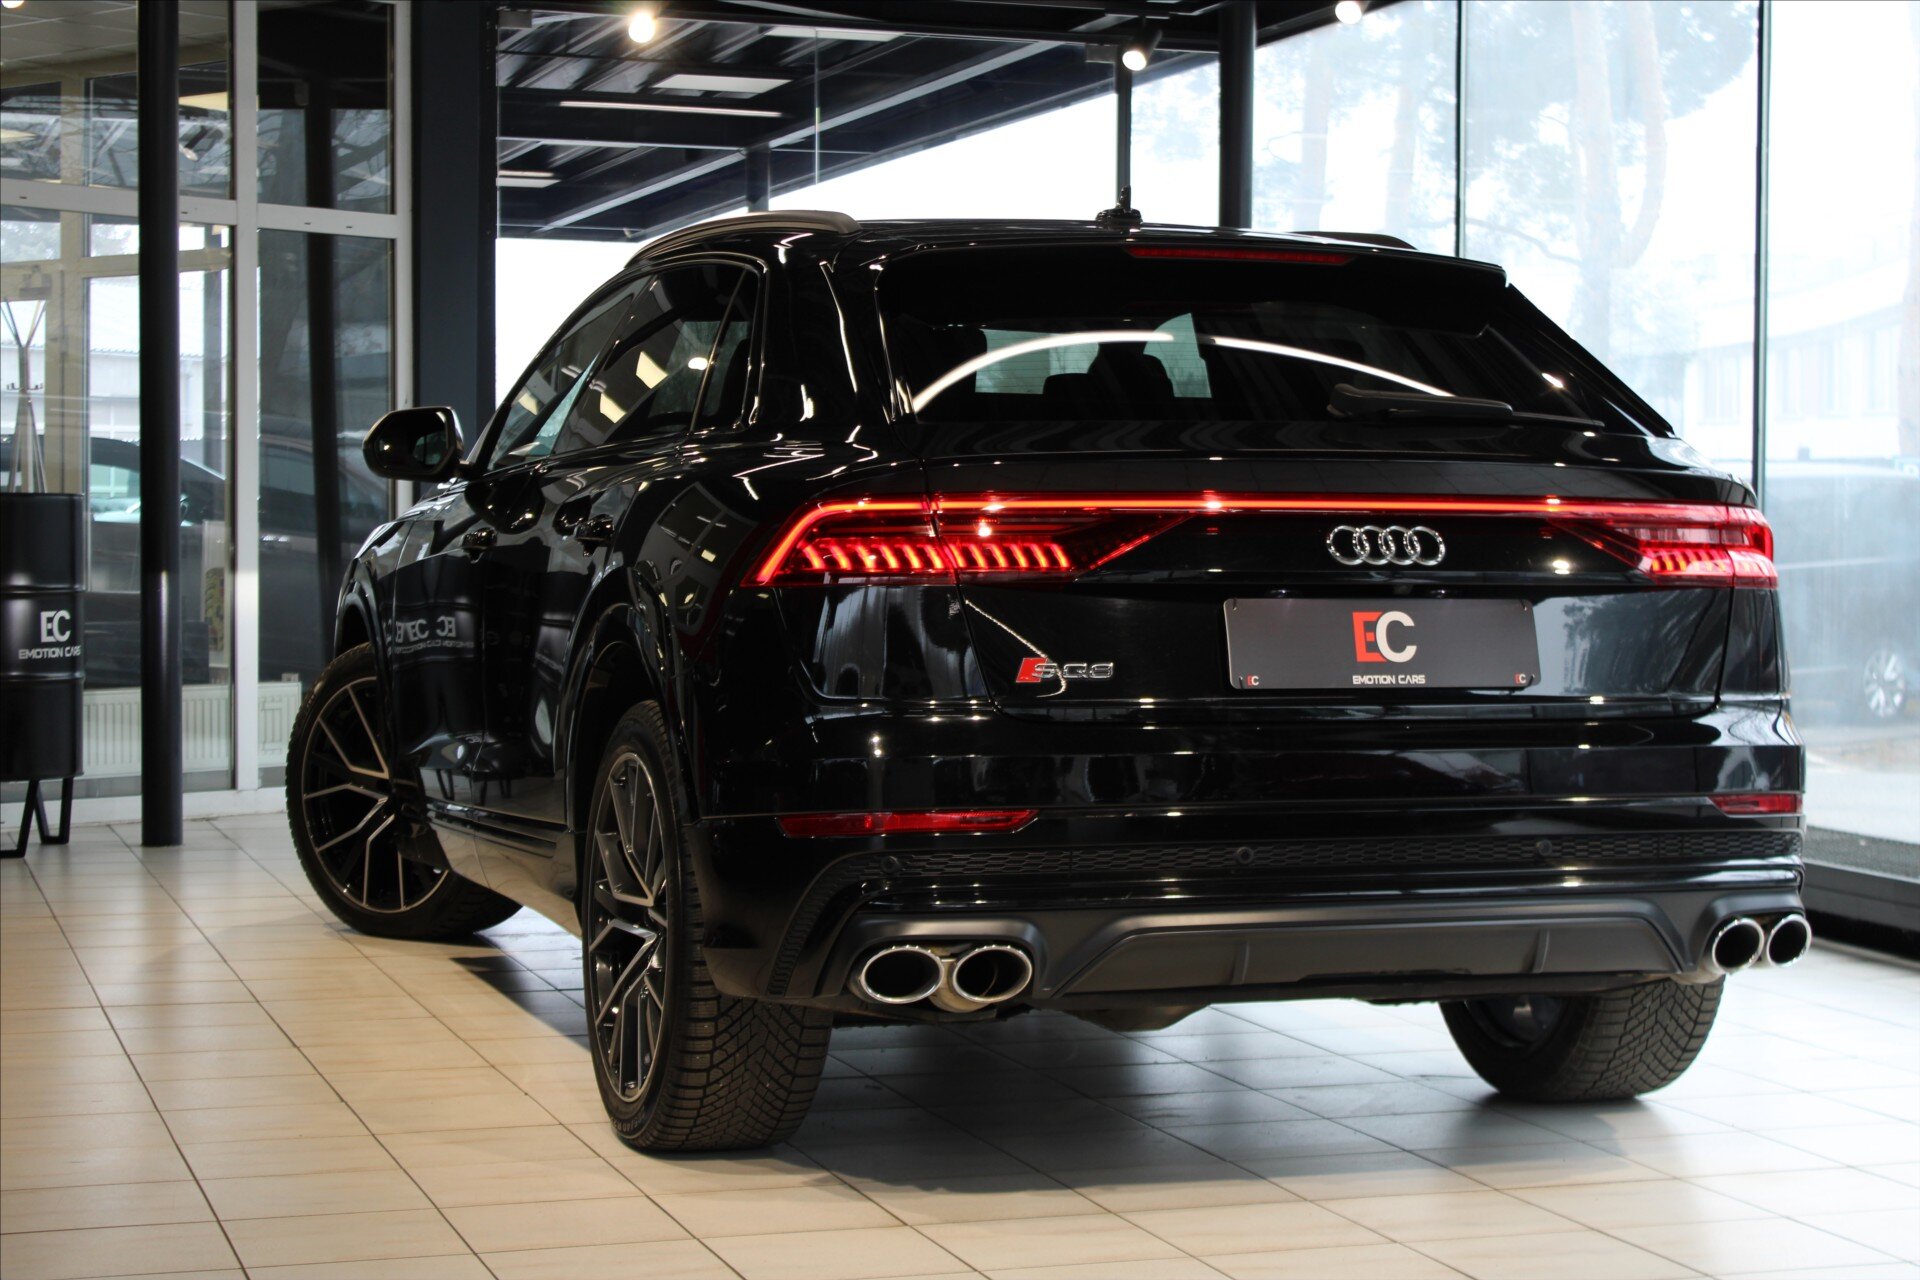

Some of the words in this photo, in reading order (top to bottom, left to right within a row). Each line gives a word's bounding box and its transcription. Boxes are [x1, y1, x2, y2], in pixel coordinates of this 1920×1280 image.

[40, 609, 71, 642] EC
[1352, 610, 1417, 663] EC
[18, 647, 63, 660] EMOTION
[1031, 662, 1114, 679] SQ8
[1352, 674, 1396, 685] EMOTION
[1398, 674, 1426, 685] CARS
